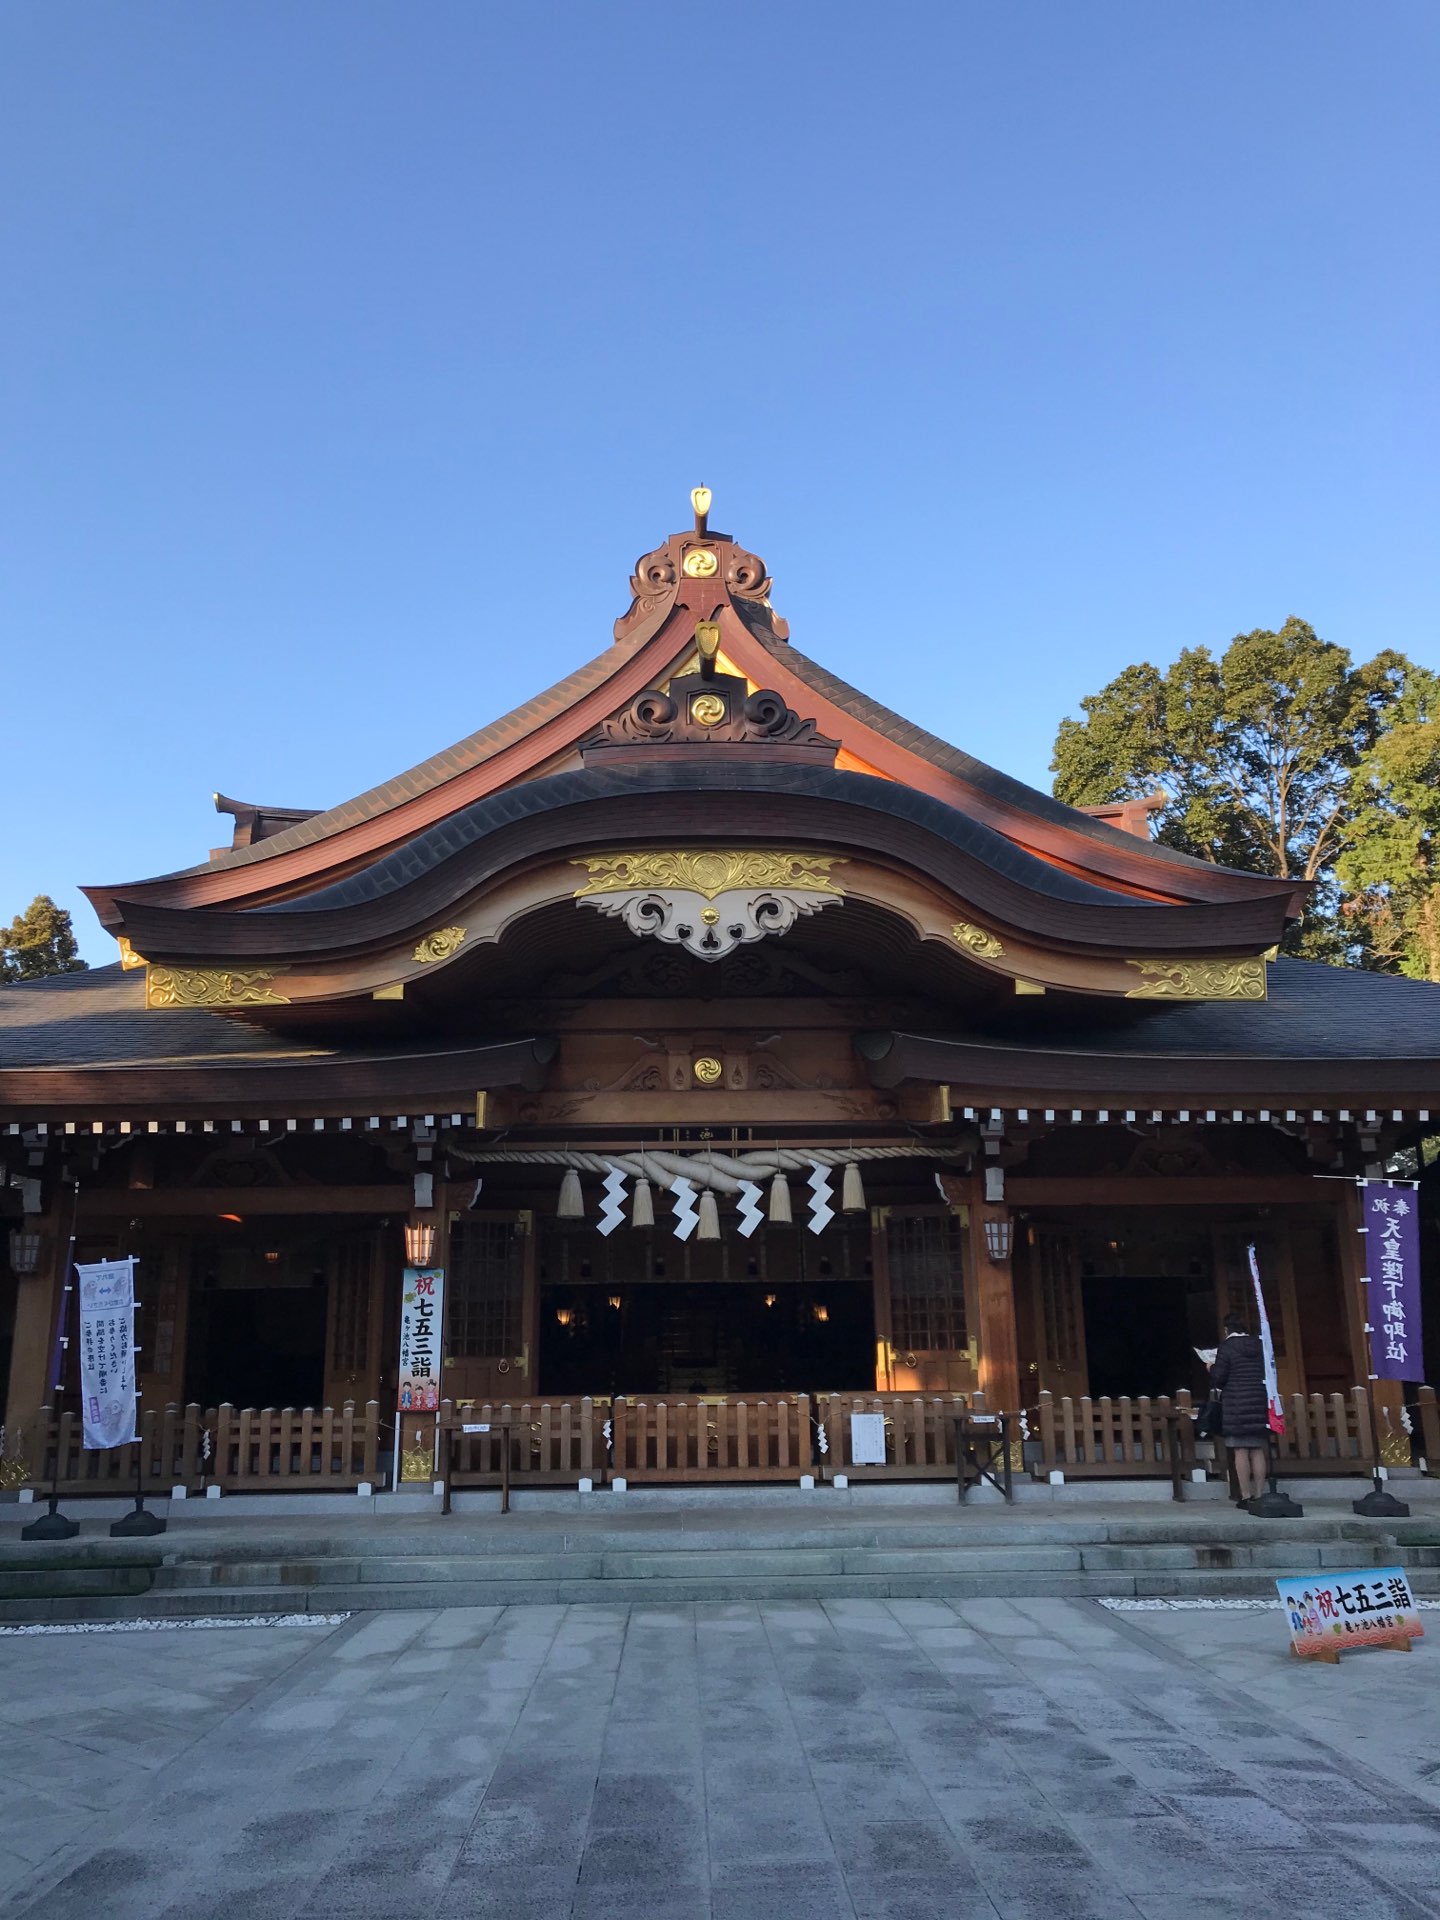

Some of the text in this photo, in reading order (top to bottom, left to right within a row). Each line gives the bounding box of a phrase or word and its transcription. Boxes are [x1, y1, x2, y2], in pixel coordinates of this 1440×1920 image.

[411, 1273, 435, 1378] 祝七五三詣
